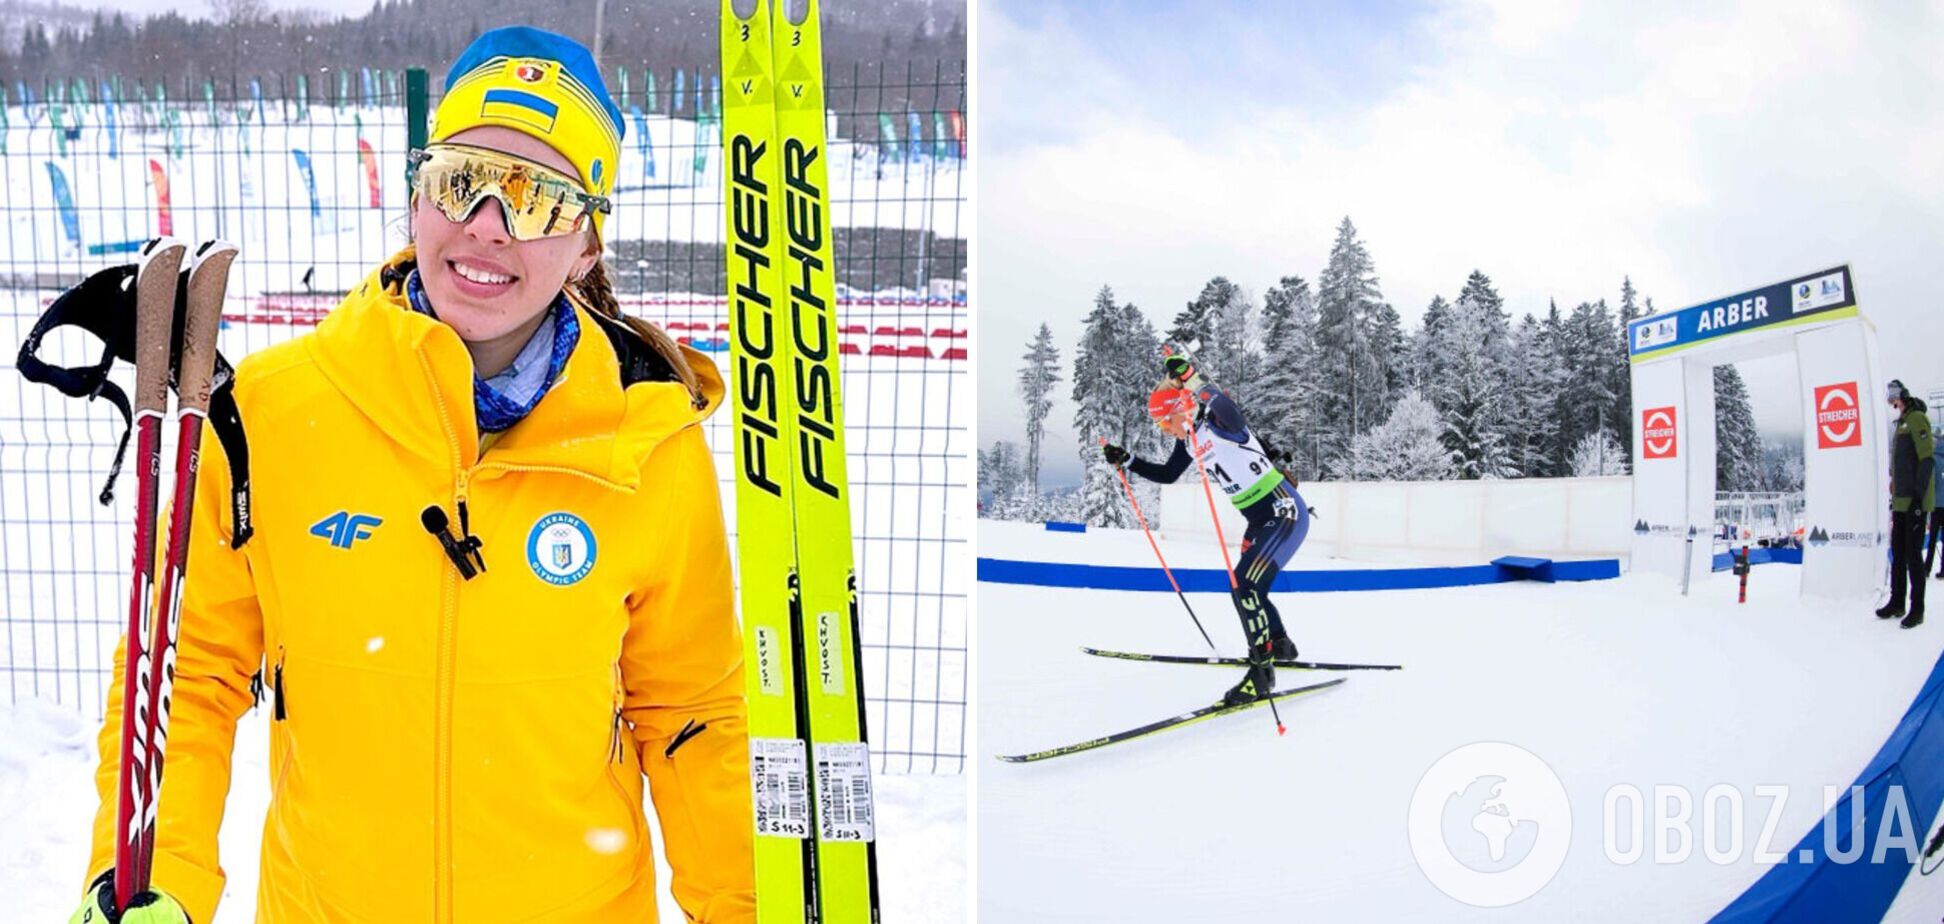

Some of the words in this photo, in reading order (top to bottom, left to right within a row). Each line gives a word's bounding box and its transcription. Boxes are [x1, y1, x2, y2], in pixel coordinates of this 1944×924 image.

[741, 24, 751, 42] 3
[792, 30, 801, 47] 3
[732, 134, 782, 498] FISCHER
[784, 138, 840, 500] FISCHER
[1697, 295, 1769, 333] ARBER
[1818, 408, 1858, 423] STREICHER
[1644, 428, 1675, 439] STREICHER
[1249, 457, 1269, 476] 91
[309, 511, 384, 550] 4F
[539, 515, 580, 529] UKRAINE
[532, 561, 571, 584] OLYMPIC
[572, 561, 593, 581] TEAM
